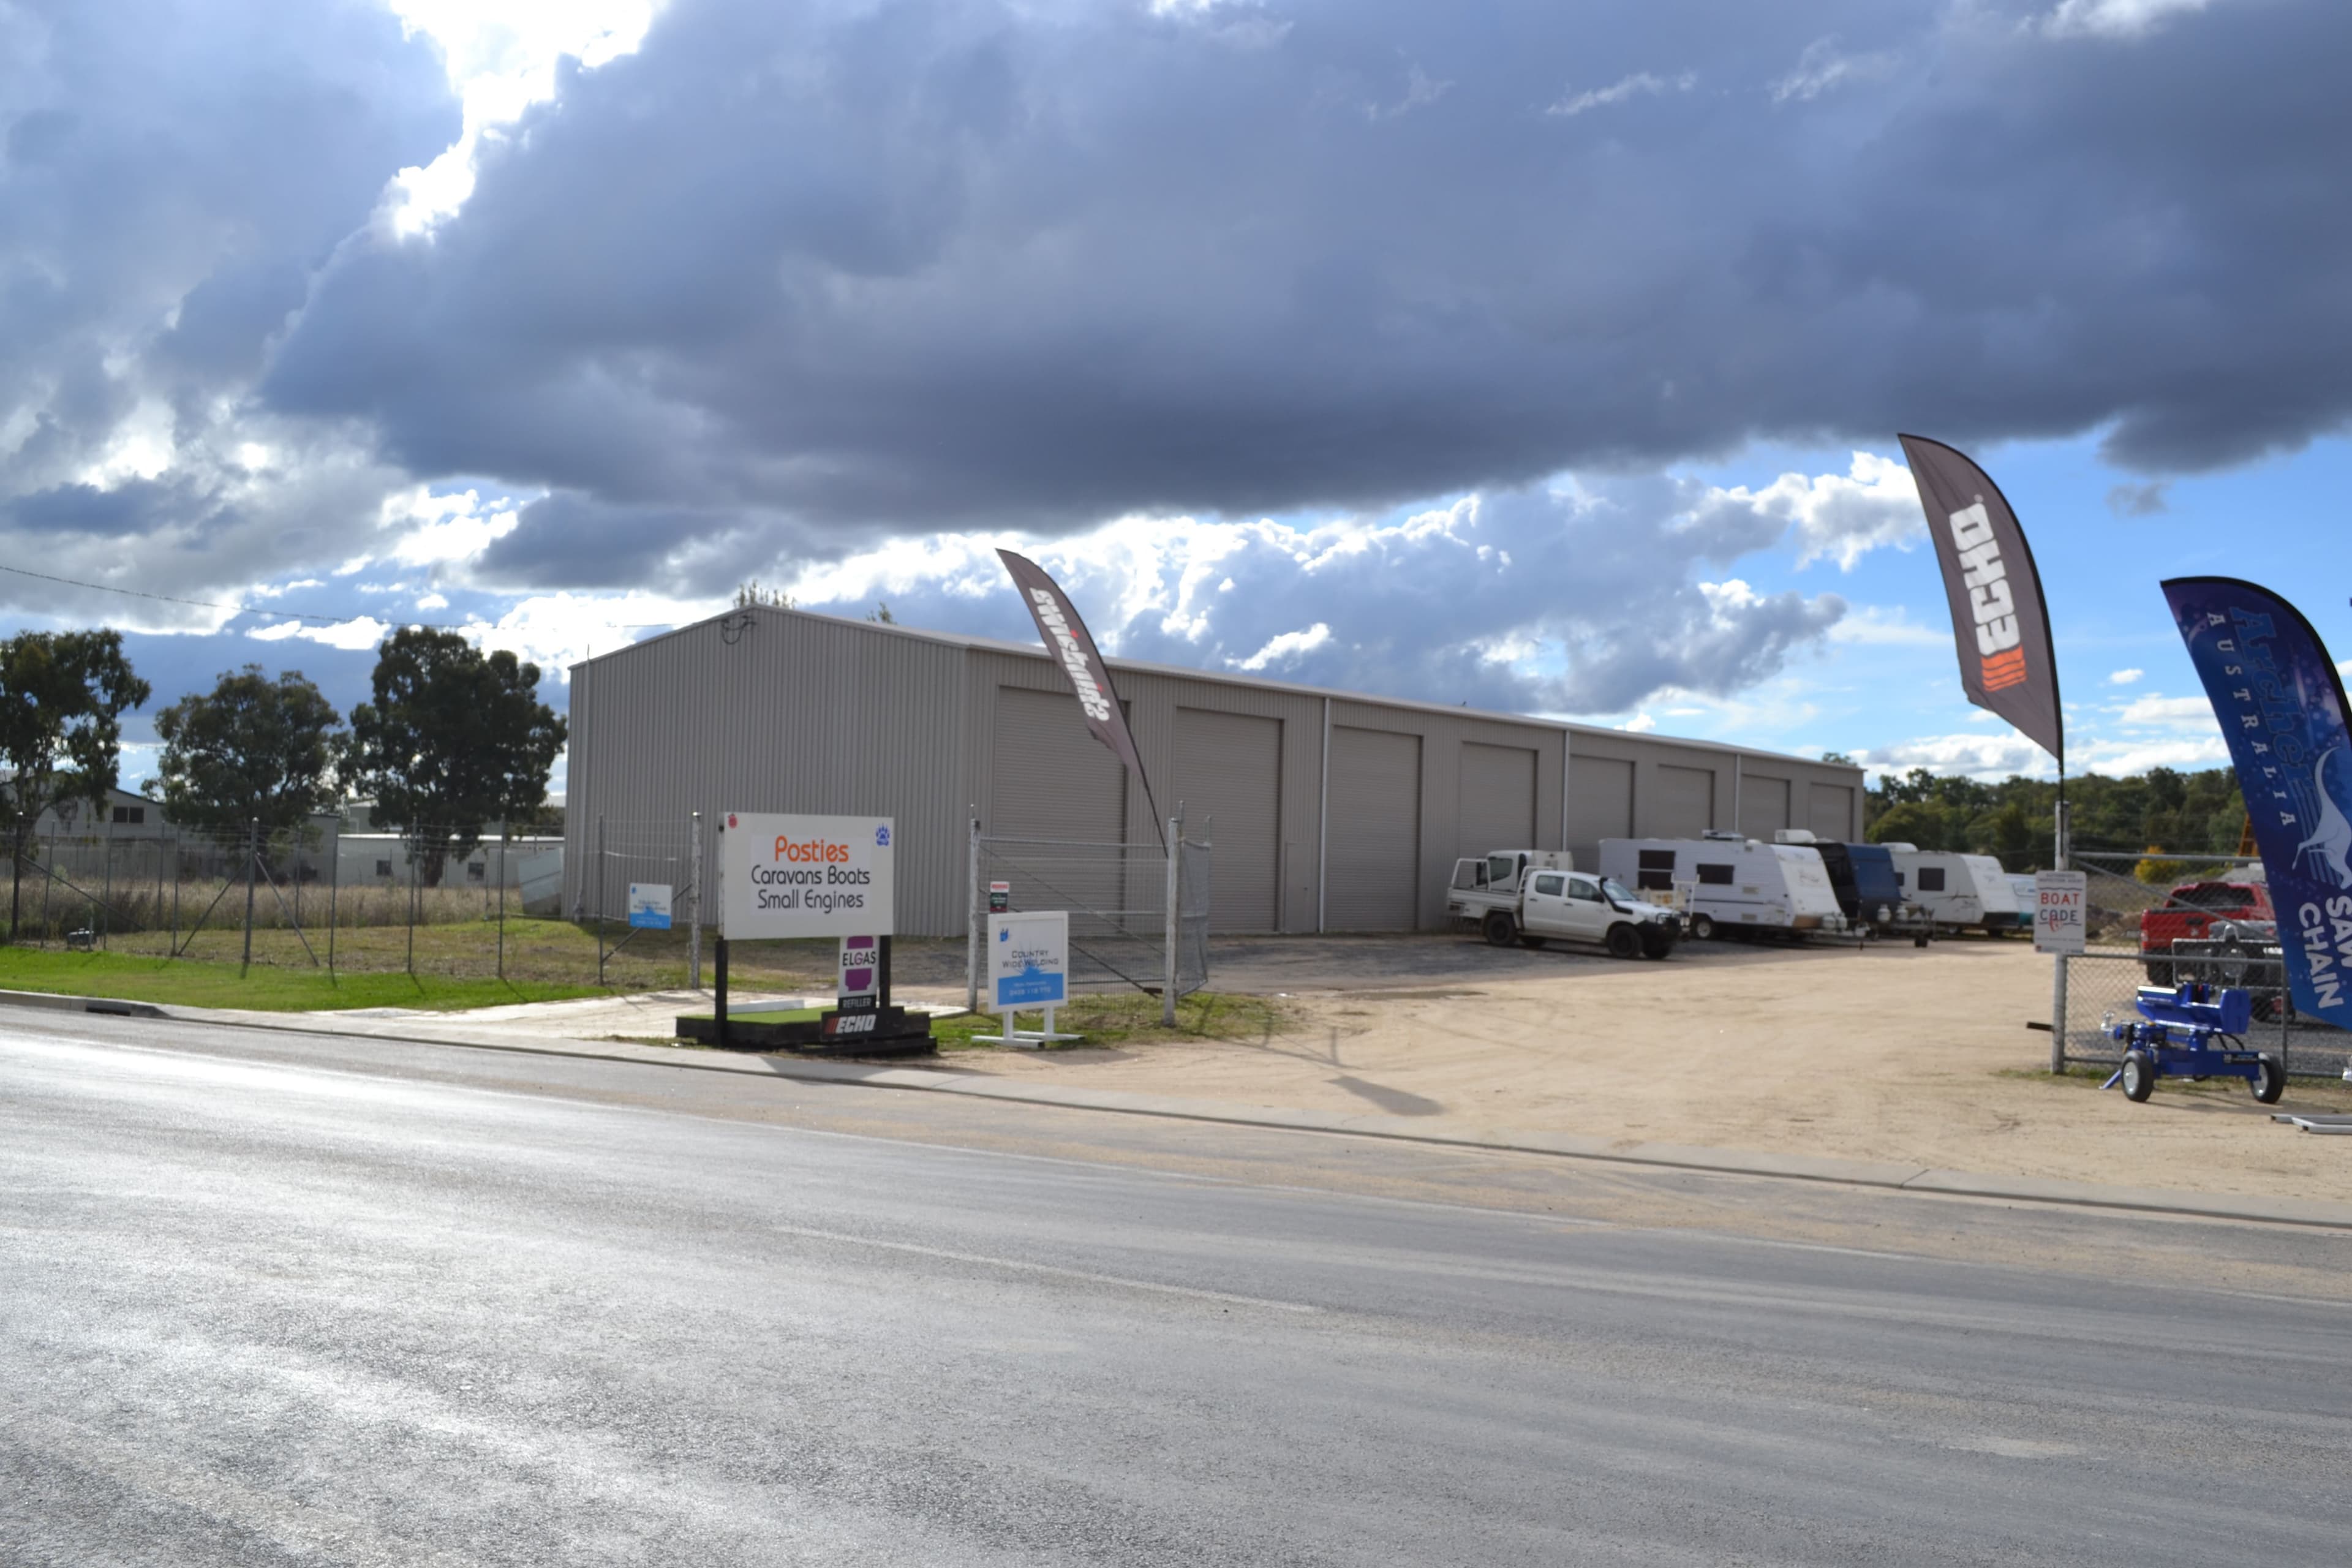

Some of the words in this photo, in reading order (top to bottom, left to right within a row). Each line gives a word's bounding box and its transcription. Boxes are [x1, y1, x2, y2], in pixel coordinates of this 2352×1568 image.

[1949, 503, 2021, 656] ECHO
[2228, 606, 2318, 790] Archer
[2207, 612, 2296, 827] AUSTRALIA
[775, 835, 850, 862] Posties
[751, 864, 822, 885] Caravans
[827, 865, 870, 885] Boats
[758, 889, 799, 909] Small
[804, 889, 864, 914] Engines
[2040, 892, 2080, 905] BOAT
[2040, 909, 2078, 922] CODE
[842, 951, 876, 966] ELGAS
[1002, 960, 1022, 968] WIDE
[1011, 950, 1049, 959] COUNTRY
[2299, 902, 2344, 1009] CHAIN
[842, 998, 872, 1009] REFILLER
[835, 1014, 876, 1034] ECHO
